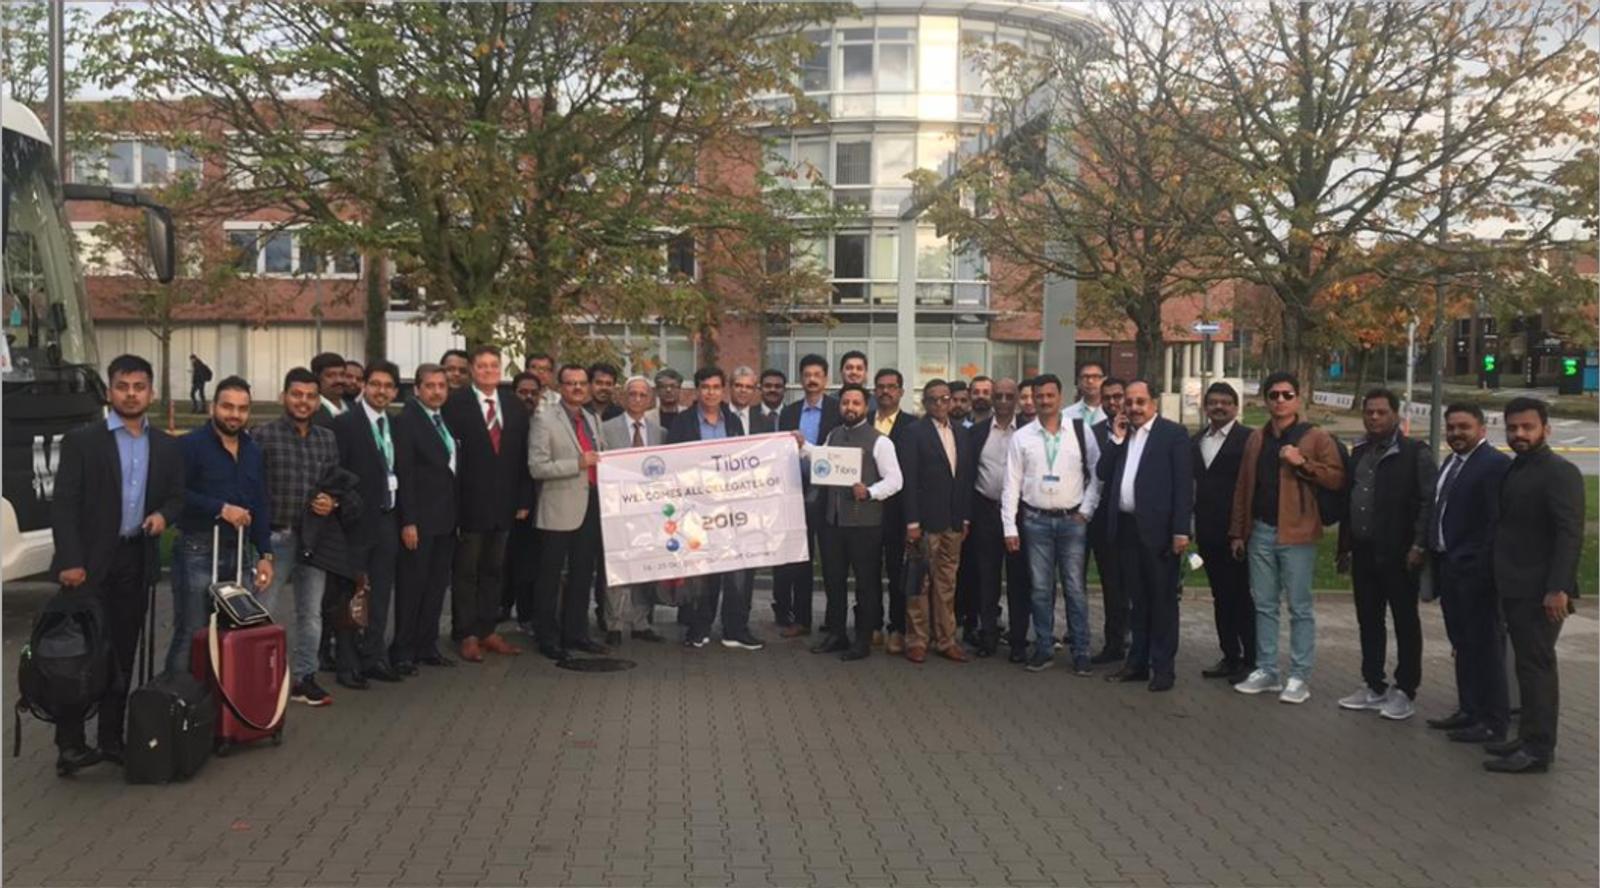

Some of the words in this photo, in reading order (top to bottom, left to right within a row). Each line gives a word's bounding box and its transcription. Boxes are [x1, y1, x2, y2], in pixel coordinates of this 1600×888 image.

[711, 454, 761, 473] Tibro
[685, 486, 704, 497] ALL
[702, 511, 749, 531] 2019
